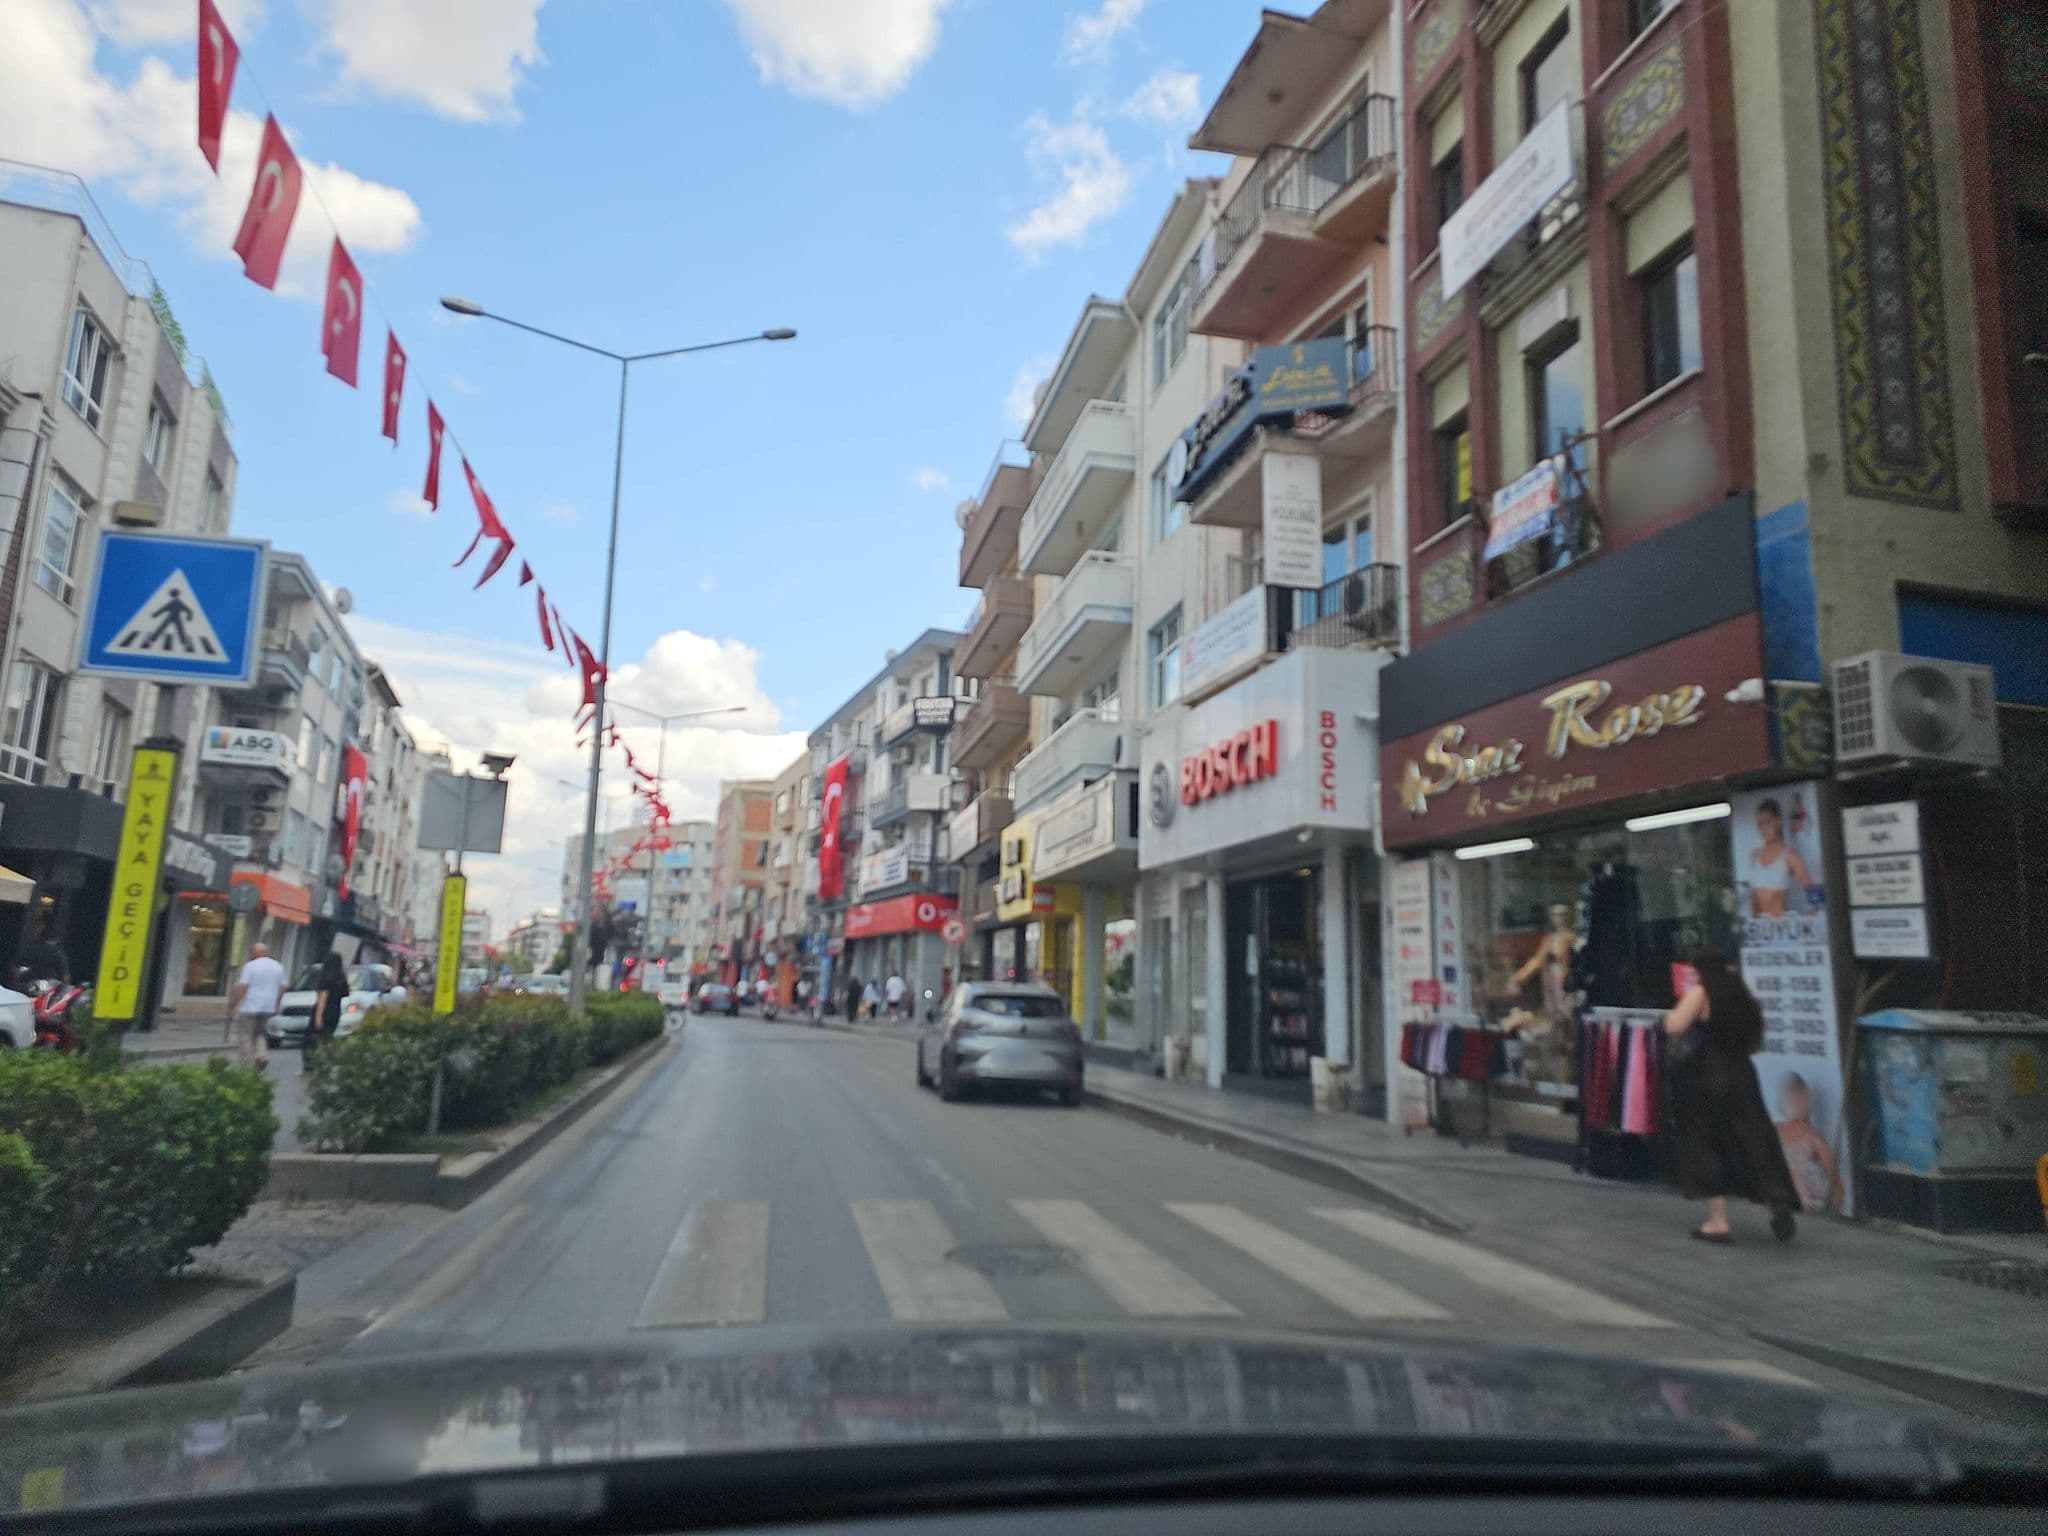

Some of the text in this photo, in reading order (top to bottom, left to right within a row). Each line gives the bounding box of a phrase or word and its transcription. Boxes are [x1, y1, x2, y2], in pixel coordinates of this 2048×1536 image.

[232, 735, 273, 750] ABG
[1181, 718, 1279, 807] BOSCH
[1319, 710, 1337, 813] BOSCH
[1541, 679, 1706, 760] Rose
[112, 793, 155, 1004] YAYA GEÇİDİ
